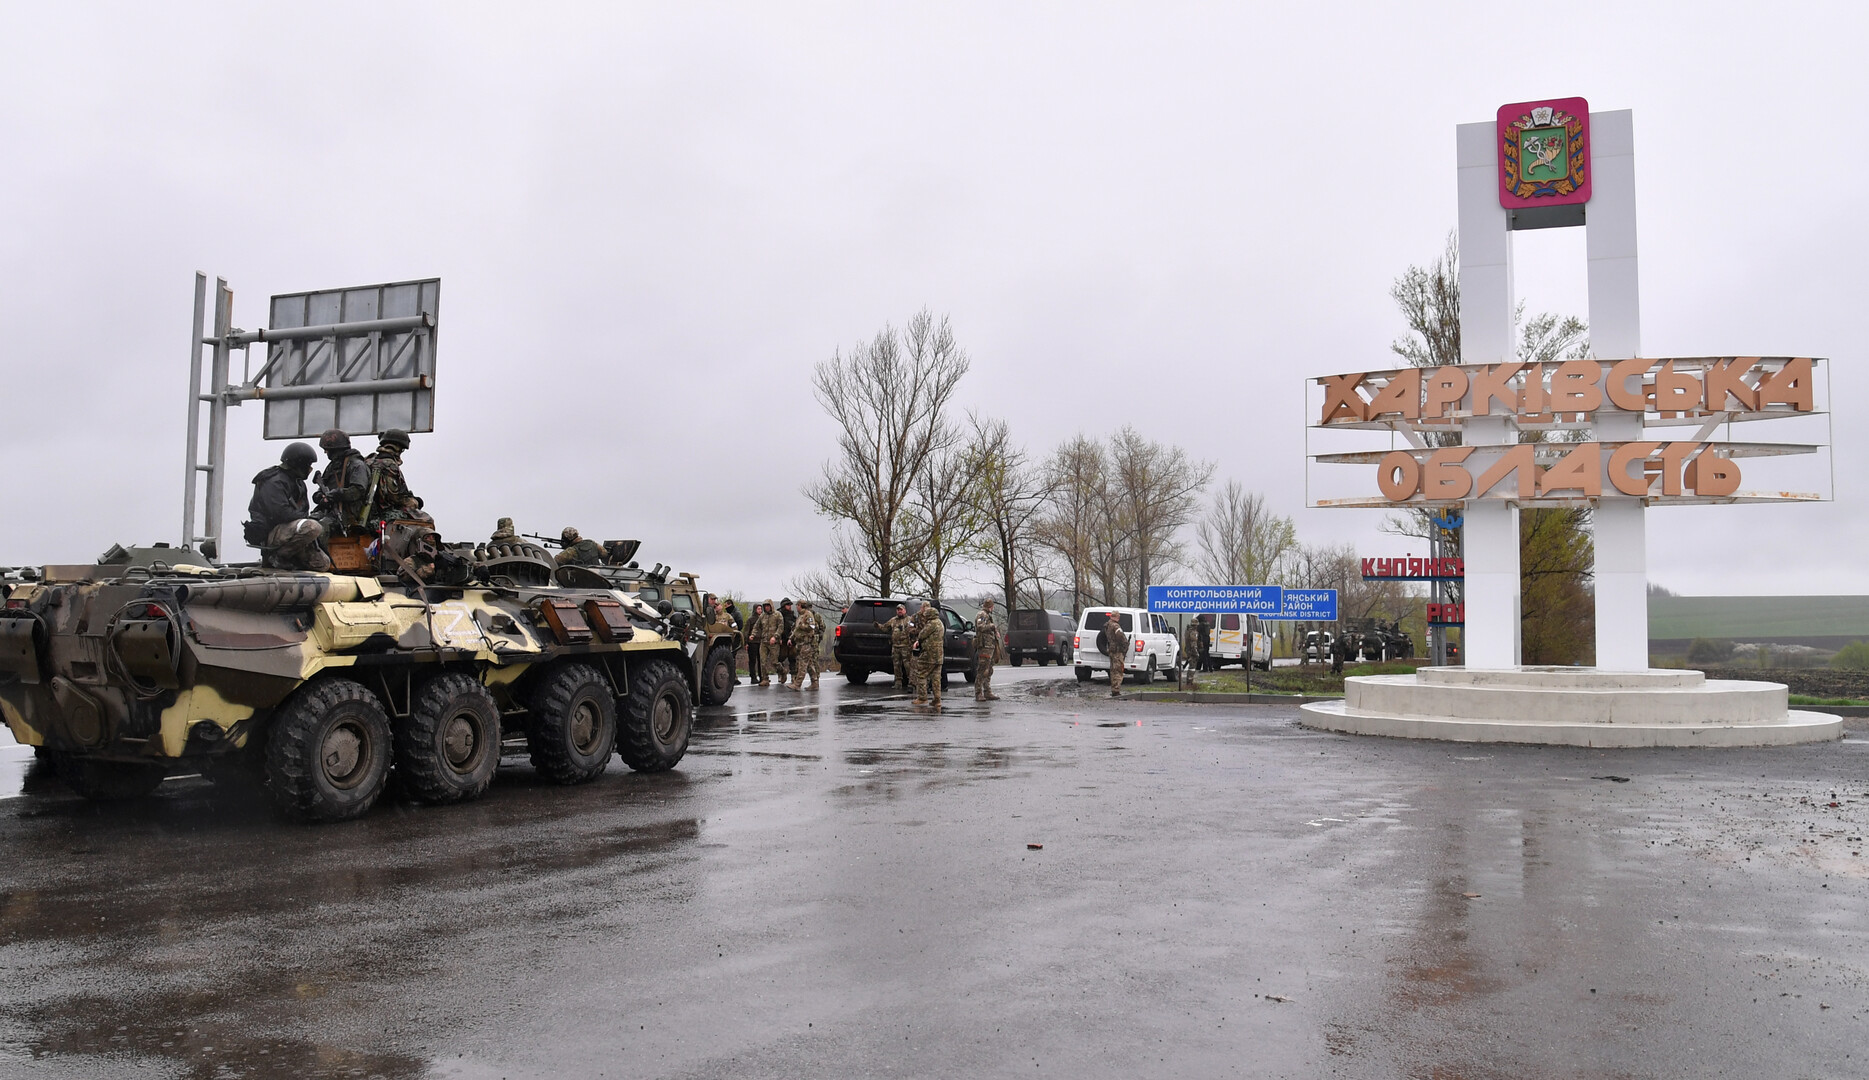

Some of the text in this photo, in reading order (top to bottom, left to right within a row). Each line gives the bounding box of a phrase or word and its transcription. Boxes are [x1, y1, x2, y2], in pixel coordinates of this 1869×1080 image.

[1322, 356, 1814, 424] ХАРКІВСЬКА
[1377, 442, 1742, 501] ОБЛАСТЬ
[1361, 552, 1465, 577] КУП'ЯНСЬ
[1154, 599, 1275, 610] ПРИКОРДОННИЙ РАЙОН
[1166, 588, 1262, 598] КОНТРОЛЬОВАНИЙ
[430, 603, 482, 641] Z
